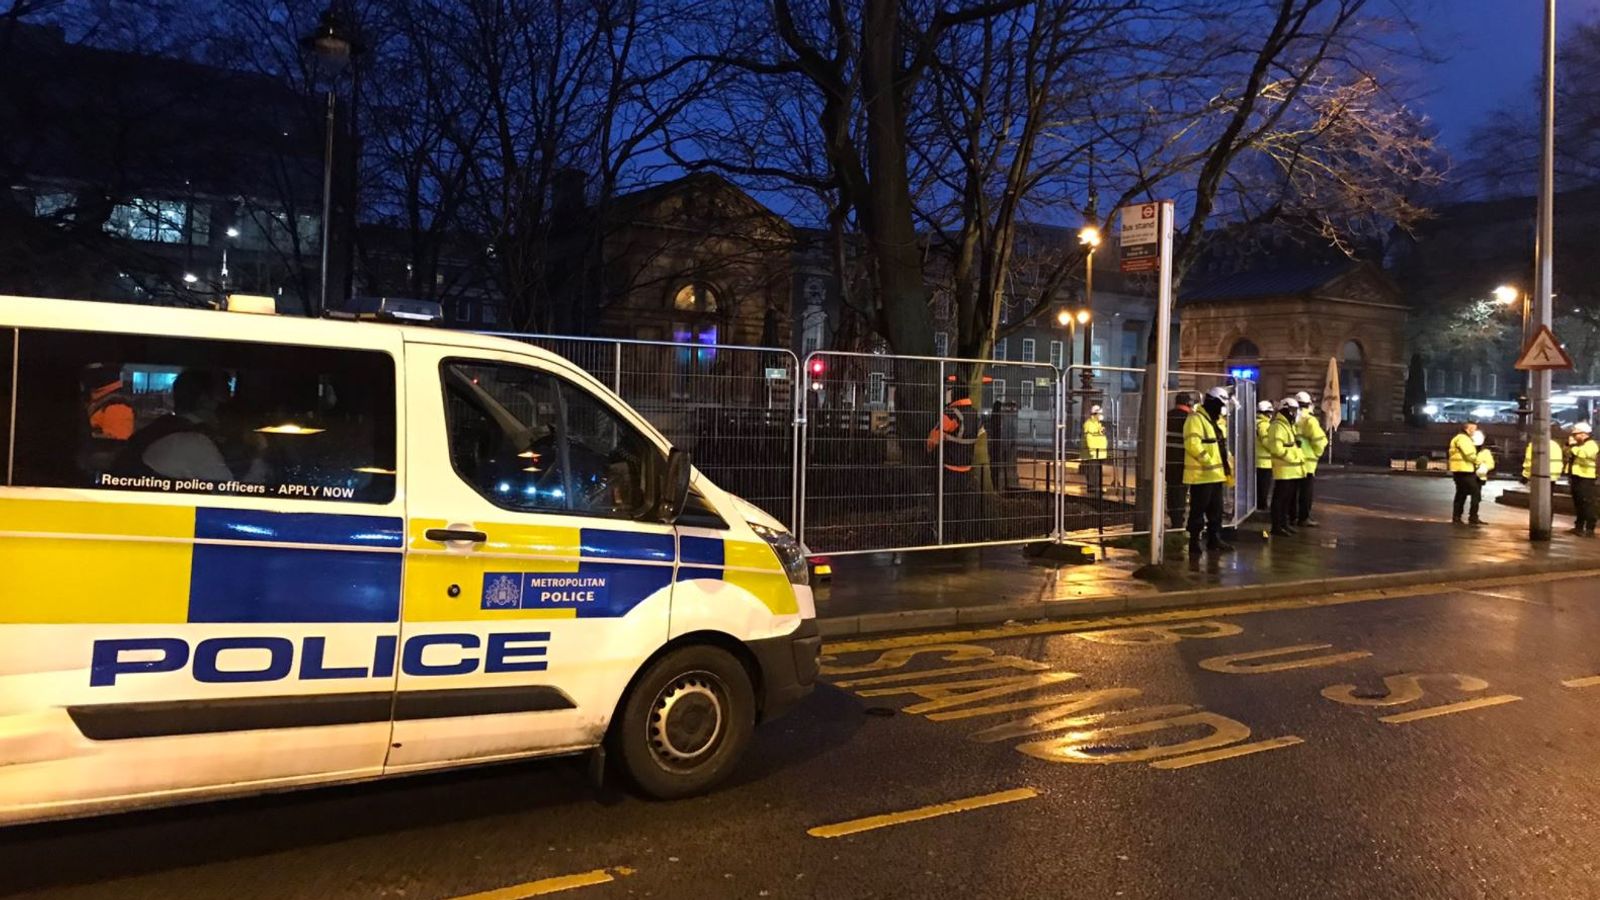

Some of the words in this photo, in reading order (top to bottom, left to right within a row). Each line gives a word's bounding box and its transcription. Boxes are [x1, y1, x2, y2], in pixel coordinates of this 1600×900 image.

[1122, 224, 1133, 232] Bus
[1135, 221, 1154, 230] stand
[102, 473, 171, 490] Recruiting
[175, 479, 214, 490] police
[217, 481, 266, 494] officers
[278, 484, 319, 496] APPLY
[322, 486, 354, 498] NOW
[531, 578, 605, 587] METROPOLITAN
[540, 591, 595, 602] POLICE
[90, 631, 551, 687] POLICE
[1075, 621, 1488, 705] BUS
